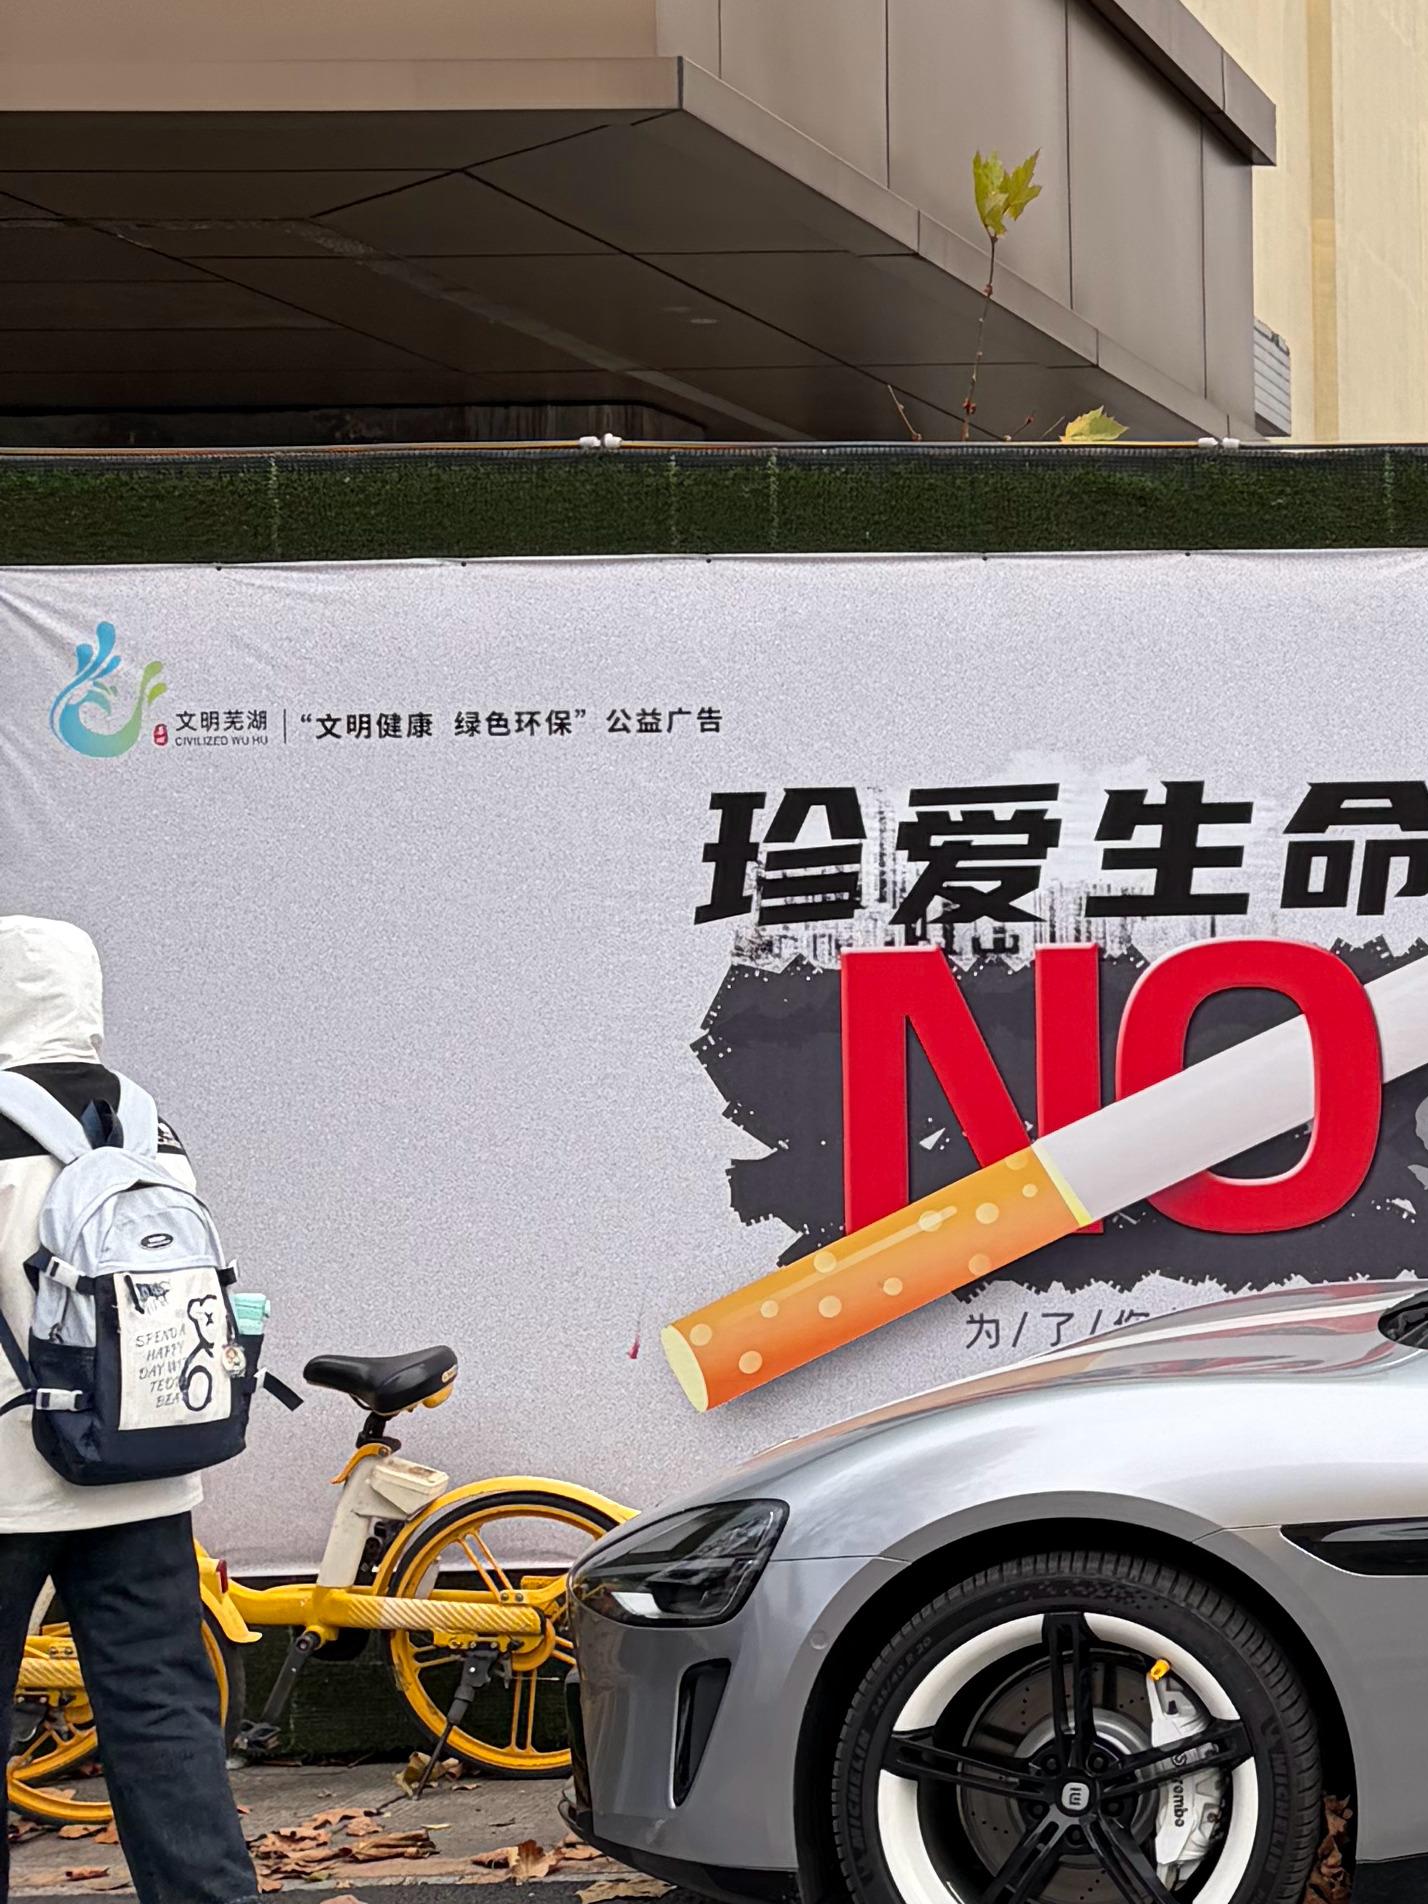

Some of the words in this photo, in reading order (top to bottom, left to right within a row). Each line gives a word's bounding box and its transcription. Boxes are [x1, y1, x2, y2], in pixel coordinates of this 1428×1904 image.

[175, 710, 268, 732] 文明芜湖
[605, 707, 723, 734] 公益广告
[175, 736, 228, 747] CIVILIZED
[231, 736, 250, 747] WU
[841, 937, 1382, 1235] NO
[136, 1327, 177, 1347] SPEND
[146, 1340, 185, 1361] HAPPY
[139, 1361, 165, 1380] DAY
[847, 1728, 872, 1856] MICHELIN
[1261, 1750, 1291, 1875] MICHELIN
